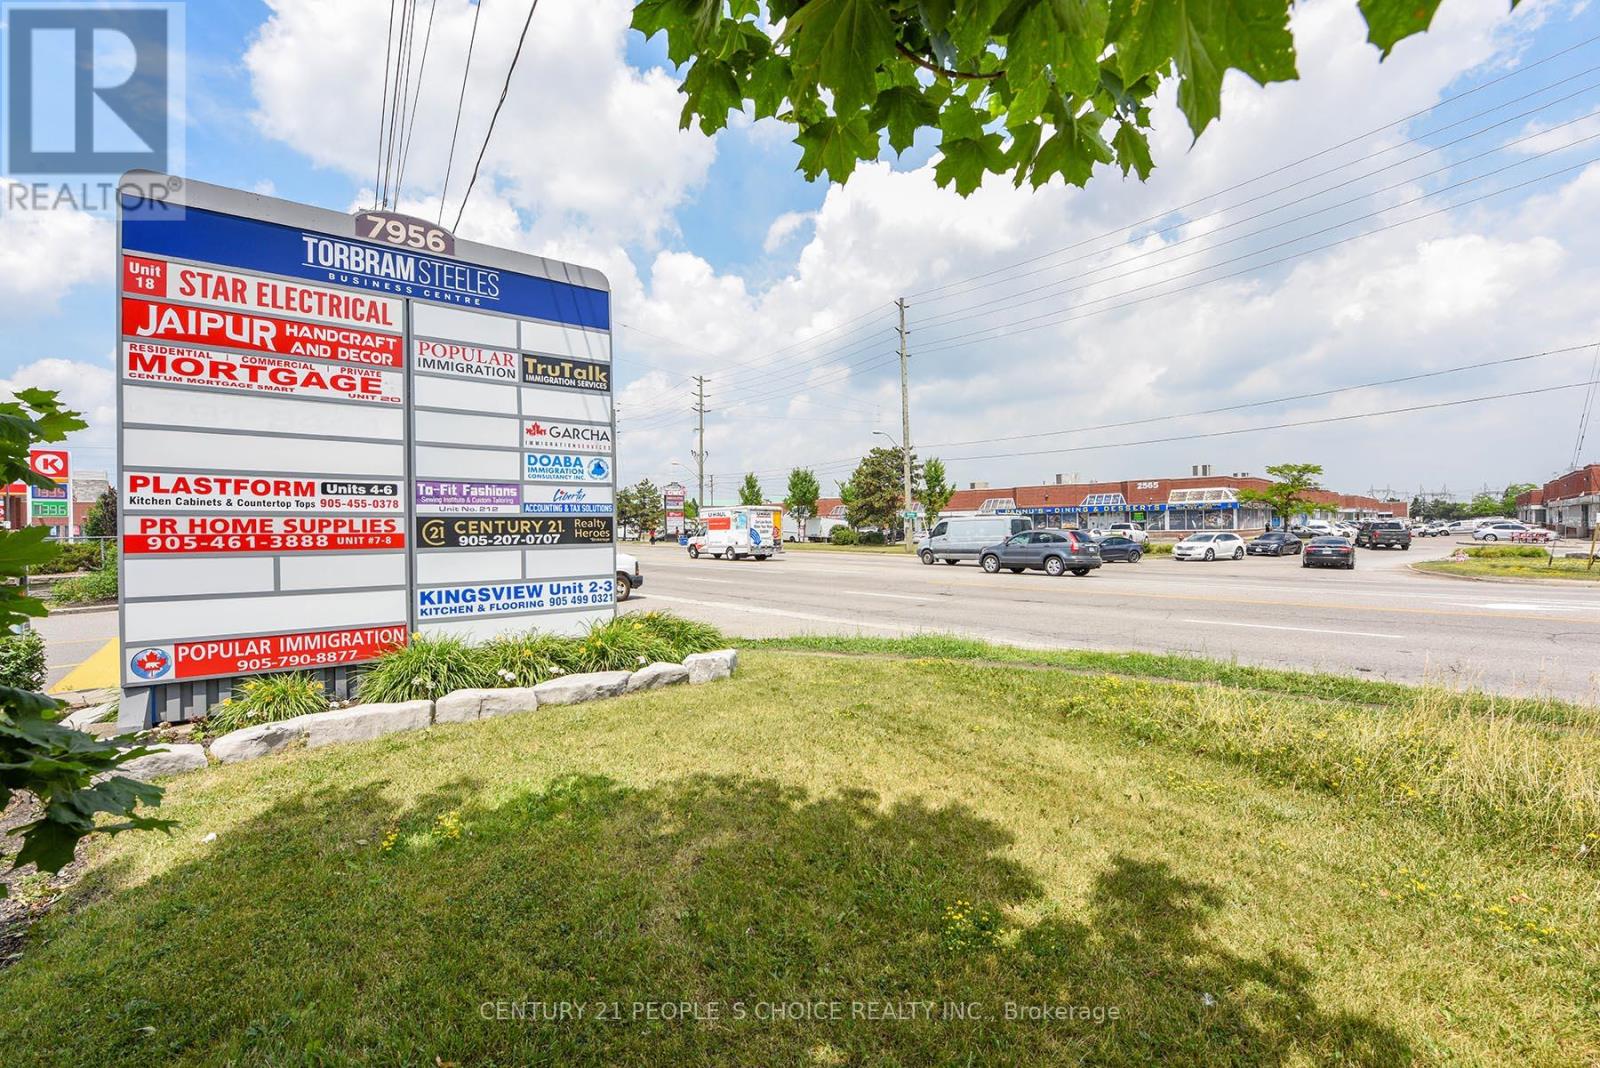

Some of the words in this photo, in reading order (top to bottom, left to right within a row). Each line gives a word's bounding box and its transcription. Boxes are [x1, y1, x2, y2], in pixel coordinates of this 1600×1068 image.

[366, 215, 447, 252] 7956
[129, 261, 161, 278] Unit
[302, 236, 416, 282] TORBRAM
[418, 259, 500, 297] STEELES
[136, 278, 156, 290] 18
[328, 272, 413, 294] BUSINESS
[423, 289, 482, 306] CENTRE
[179, 269, 248, 305] STAR
[256, 281, 394, 326] ELECTRICAL
[136, 305, 278, 352] JAIPUR
[285, 323, 398, 350] HANDCRAFT
[129, 343, 214, 360] RESIDENTIAL
[241, 355, 316, 371] COMMERCIAL
[340, 366, 383, 378] PRIVATE
[290, 341, 331, 359] AND
[337, 347, 394, 366] DECOR
[418, 340, 516, 368] POPULAR
[128, 352, 383, 395] MORTGAGE
[417, 357, 517, 380] IMMIGRATION
[523, 357, 610, 384] TruTalk
[128, 372, 184, 384] CENTUM
[186, 378, 254, 390] MORTGAGE
[257, 384, 297, 393] SMART
[525, 374, 576, 388] IMMIGRATION
[577, 378, 608, 391] SERVICES
[347, 393, 378, 402] UNIT
[379, 395, 402, 404] 20
[549, 426, 611, 443] GARCHA
[527, 454, 584, 467] DOABA
[527, 467, 584, 475] IMMIGRATION
[129, 475, 317, 497] PLASTFORM
[326, 482, 366, 495] Units
[370, 484, 393, 496] 4-6
[416, 483, 458, 497] To-Fit
[463, 485, 518, 498] Fashions
[129, 495, 172, 506] Kitchen
[175, 496, 222, 508] Cabinets
[226, 498, 233, 507] &
[237, 498, 292, 510] Countertop
[295, 499, 316, 509] Tops
[553, 488, 588, 502] Liberty
[319, 498, 399, 509] 905-455-0378
[525, 504, 563, 513] ACCOUNTING
[564, 504, 570, 513] &
[570, 504, 581, 513] TAX
[582, 504, 613, 513] SOLUTIONS
[1103, 504, 1160, 513] DESSERTS
[140, 518, 178, 534] PR
[189, 518, 274, 534] HOME
[283, 518, 397, 534] SUPPLIES
[454, 520, 544, 534] CENTURY
[574, 518, 607, 529] Realty
[336, 536, 365, 545] UNIT
[367, 536, 392, 545] #7-8
[458, 534, 561, 546] 905-207-0707
[574, 528, 610, 538] Heroes
[147, 535, 330, 551] 905-461-3888
[420, 584, 544, 606] KINGSVIEW
[549, 582, 583, 596] Unit
[588, 580, 613, 593] 2-3
[549, 597, 568, 607] 905
[570, 595, 588, 606] 499
[591, 593, 614, 604] 0321
[420, 605, 474, 616] KITCHEN
[477, 603, 486, 613] &
[489, 600, 544, 612] FLOORING
[178, 638, 271, 663] POPULAR
[279, 628, 406, 653] IMMIGRATION
[236, 650, 358, 672] 905-790-8877
